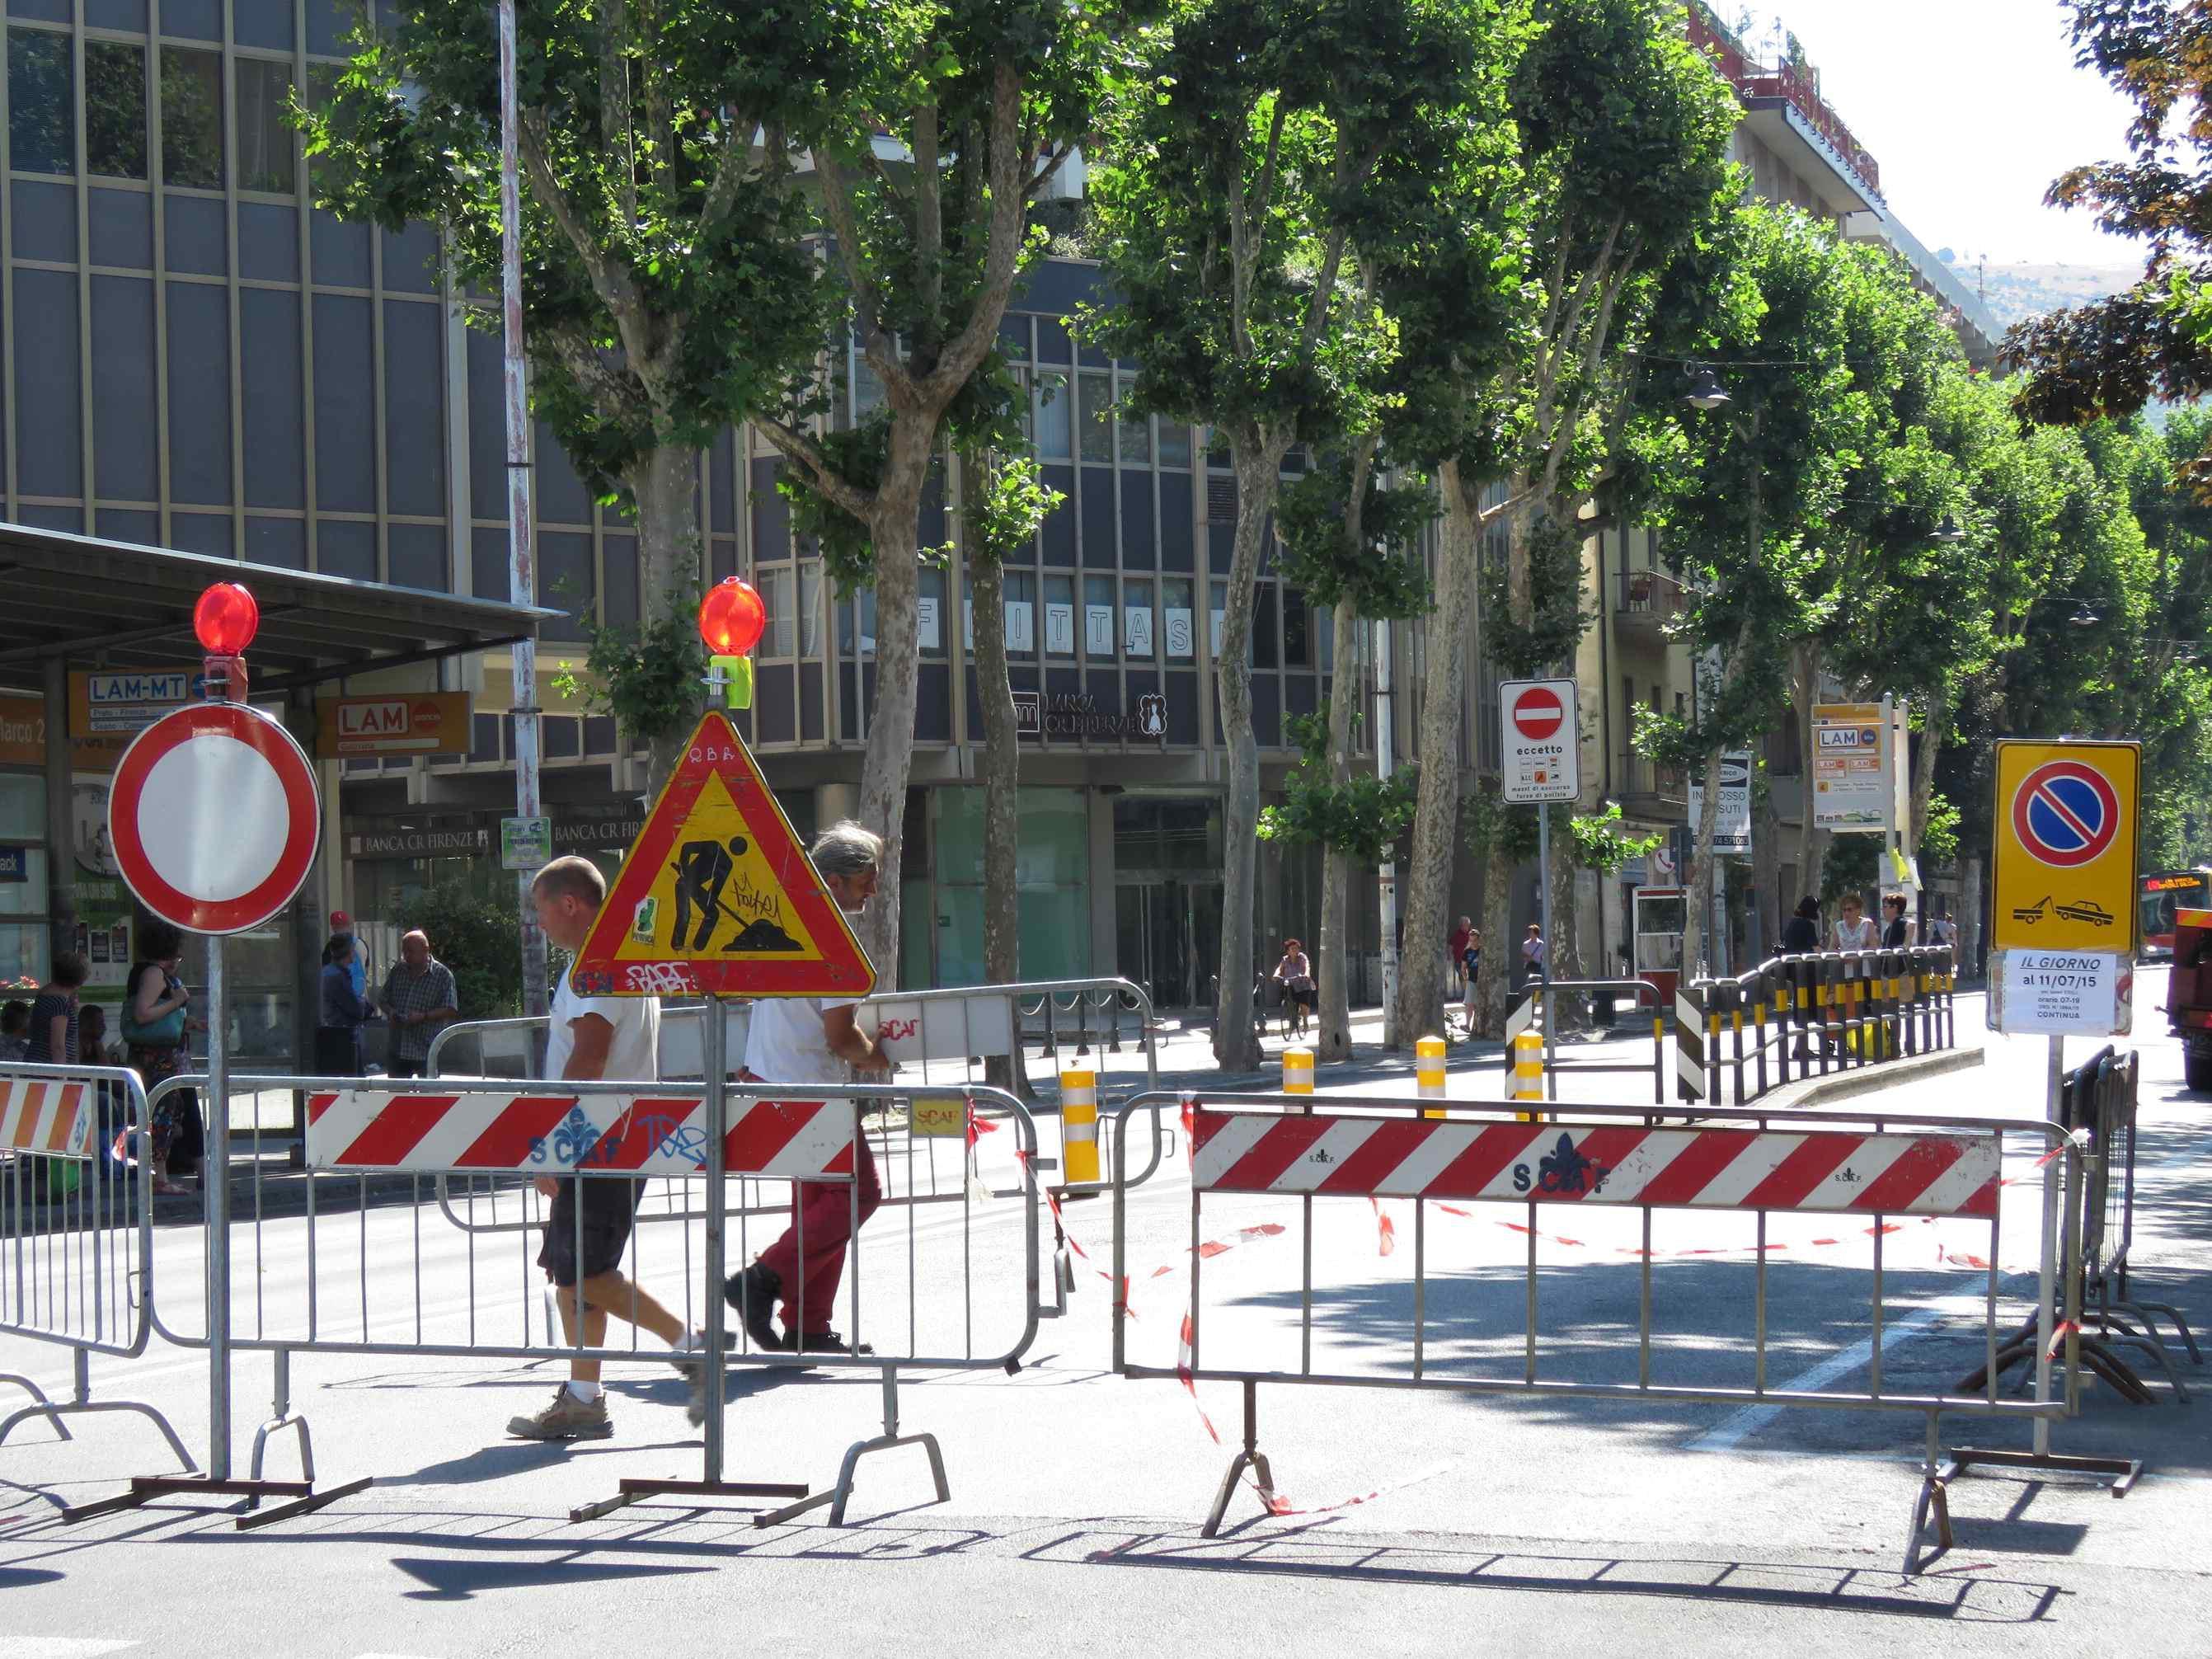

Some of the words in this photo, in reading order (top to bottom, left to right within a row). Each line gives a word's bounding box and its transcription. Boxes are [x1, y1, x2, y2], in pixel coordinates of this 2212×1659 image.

[93, 677, 184, 700] LAM-MT
[342, 706, 403, 732] LAM
[1821, 731, 1856, 745] LAM
[1517, 745, 1563, 755] eccetto
[555, 824, 596, 841] BANCA
[599, 822, 621, 839] CR
[366, 836, 405, 852] BANCA
[407, 834, 425, 850] CR
[428, 831, 473, 849] FIRENZE
[2022, 956, 2034, 967] IL
[2040, 956, 2102, 970] GIORNO
[2023, 975, 2035, 985] al
[2040, 975, 2097, 989] 11/07/15
[2037, 1011, 2080, 1019] CONTINUA
